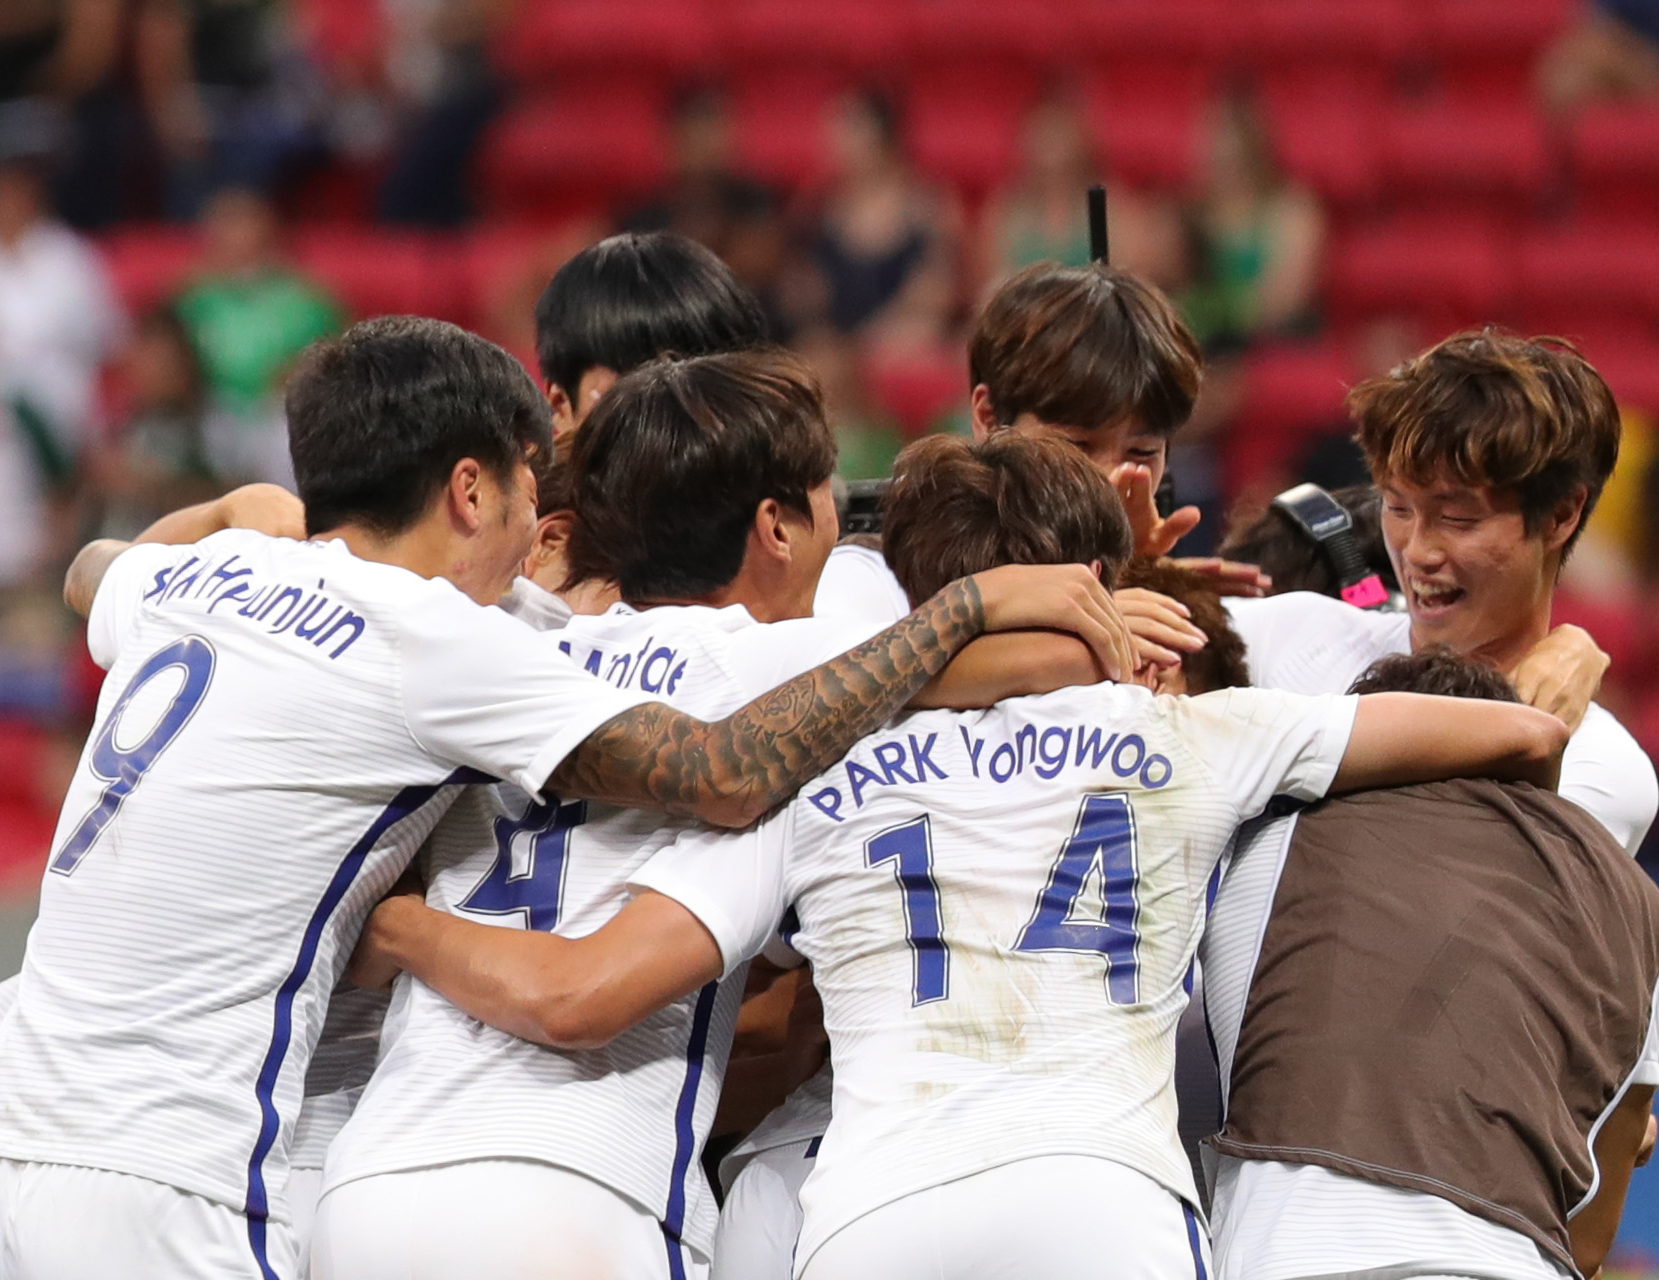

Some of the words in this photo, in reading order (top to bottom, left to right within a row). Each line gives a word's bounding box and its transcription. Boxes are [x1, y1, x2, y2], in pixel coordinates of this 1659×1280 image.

[50, 633, 217, 878] 9
[808, 733, 949, 821] PARK
[959, 723, 1173, 789] Yongwoo
[454, 795, 588, 932] 4
[864, 790, 1141, 1008] 14
